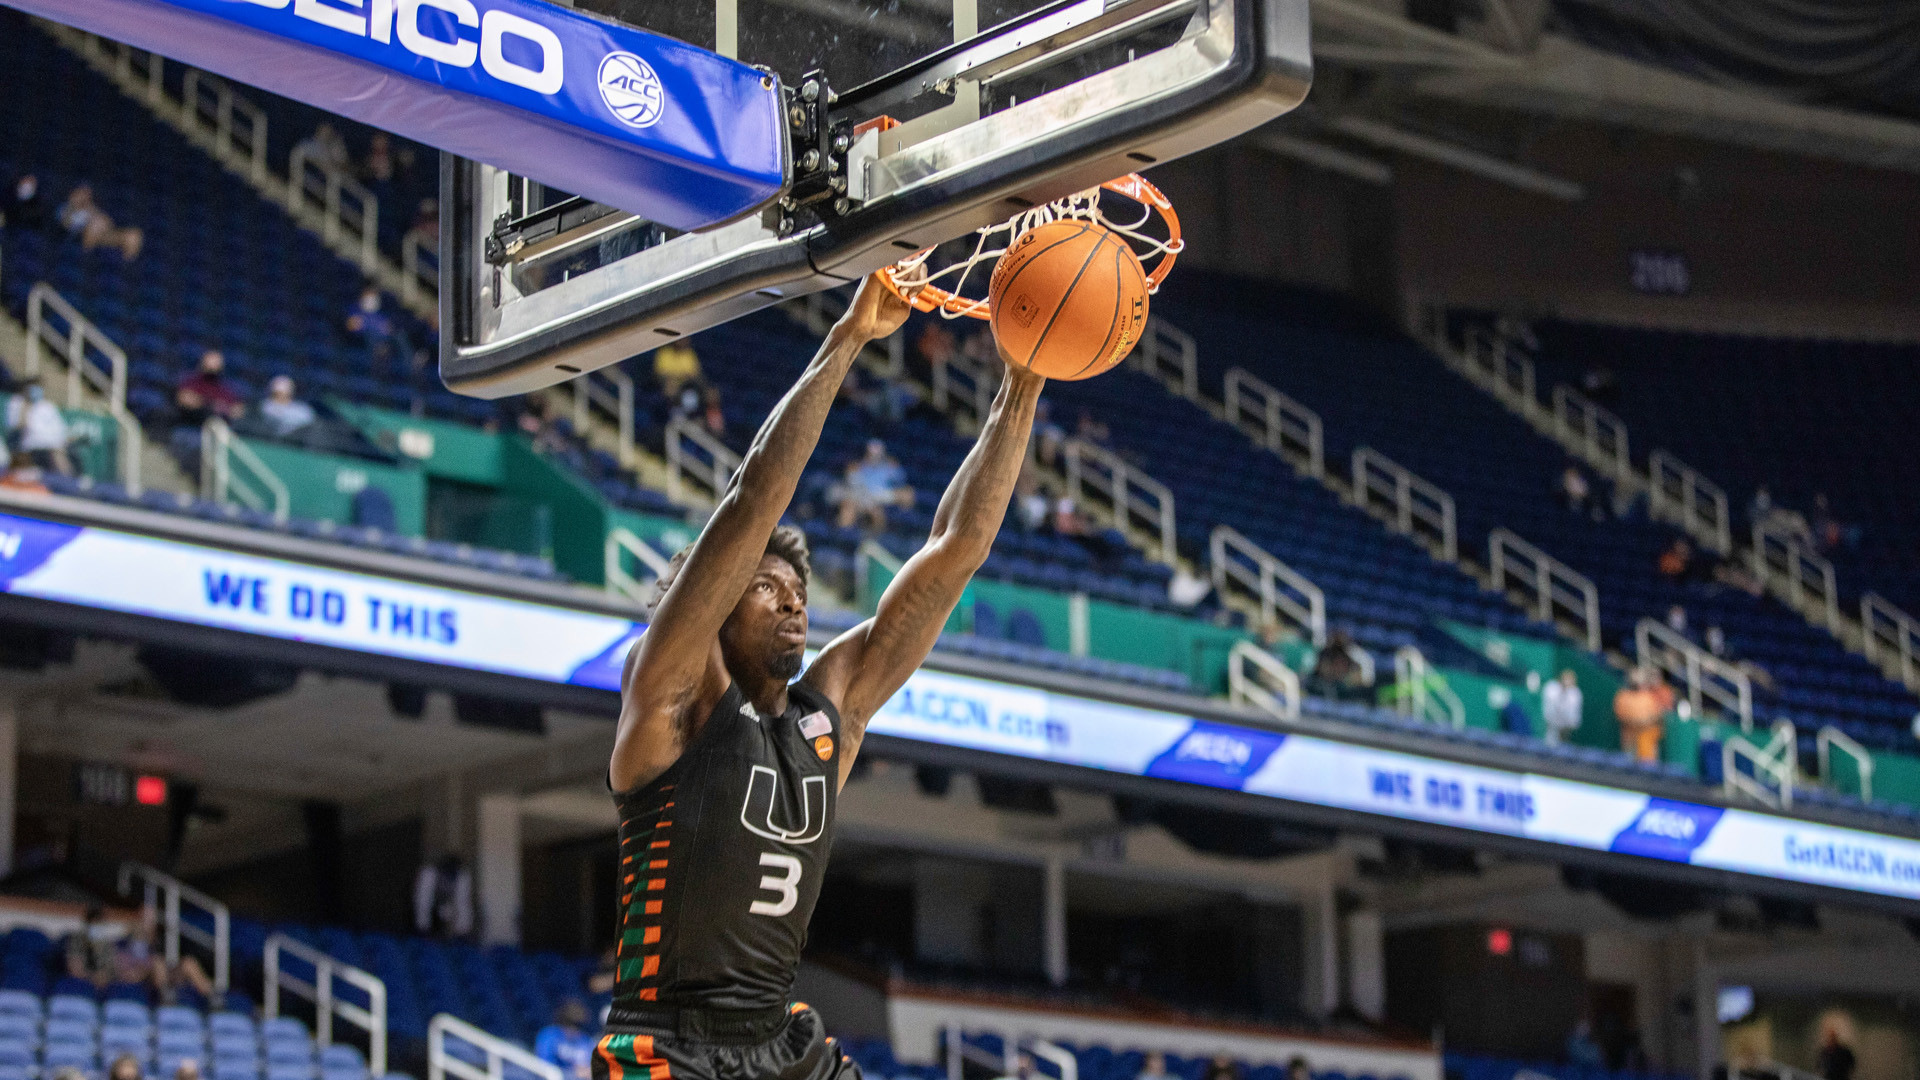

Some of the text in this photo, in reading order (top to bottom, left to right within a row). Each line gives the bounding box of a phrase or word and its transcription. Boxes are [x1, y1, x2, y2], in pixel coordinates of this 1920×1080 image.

[243, 0, 563, 94] ICO
[608, 75, 659, 100] ACC
[204, 567, 460, 648] WE DO THIS
[895, 689, 1071, 747] ACCN.com
[1368, 768, 1535, 823] WE DO THIS
[749, 852, 802, 917] 3
[1783, 833, 1920, 882] GetACCN.co
